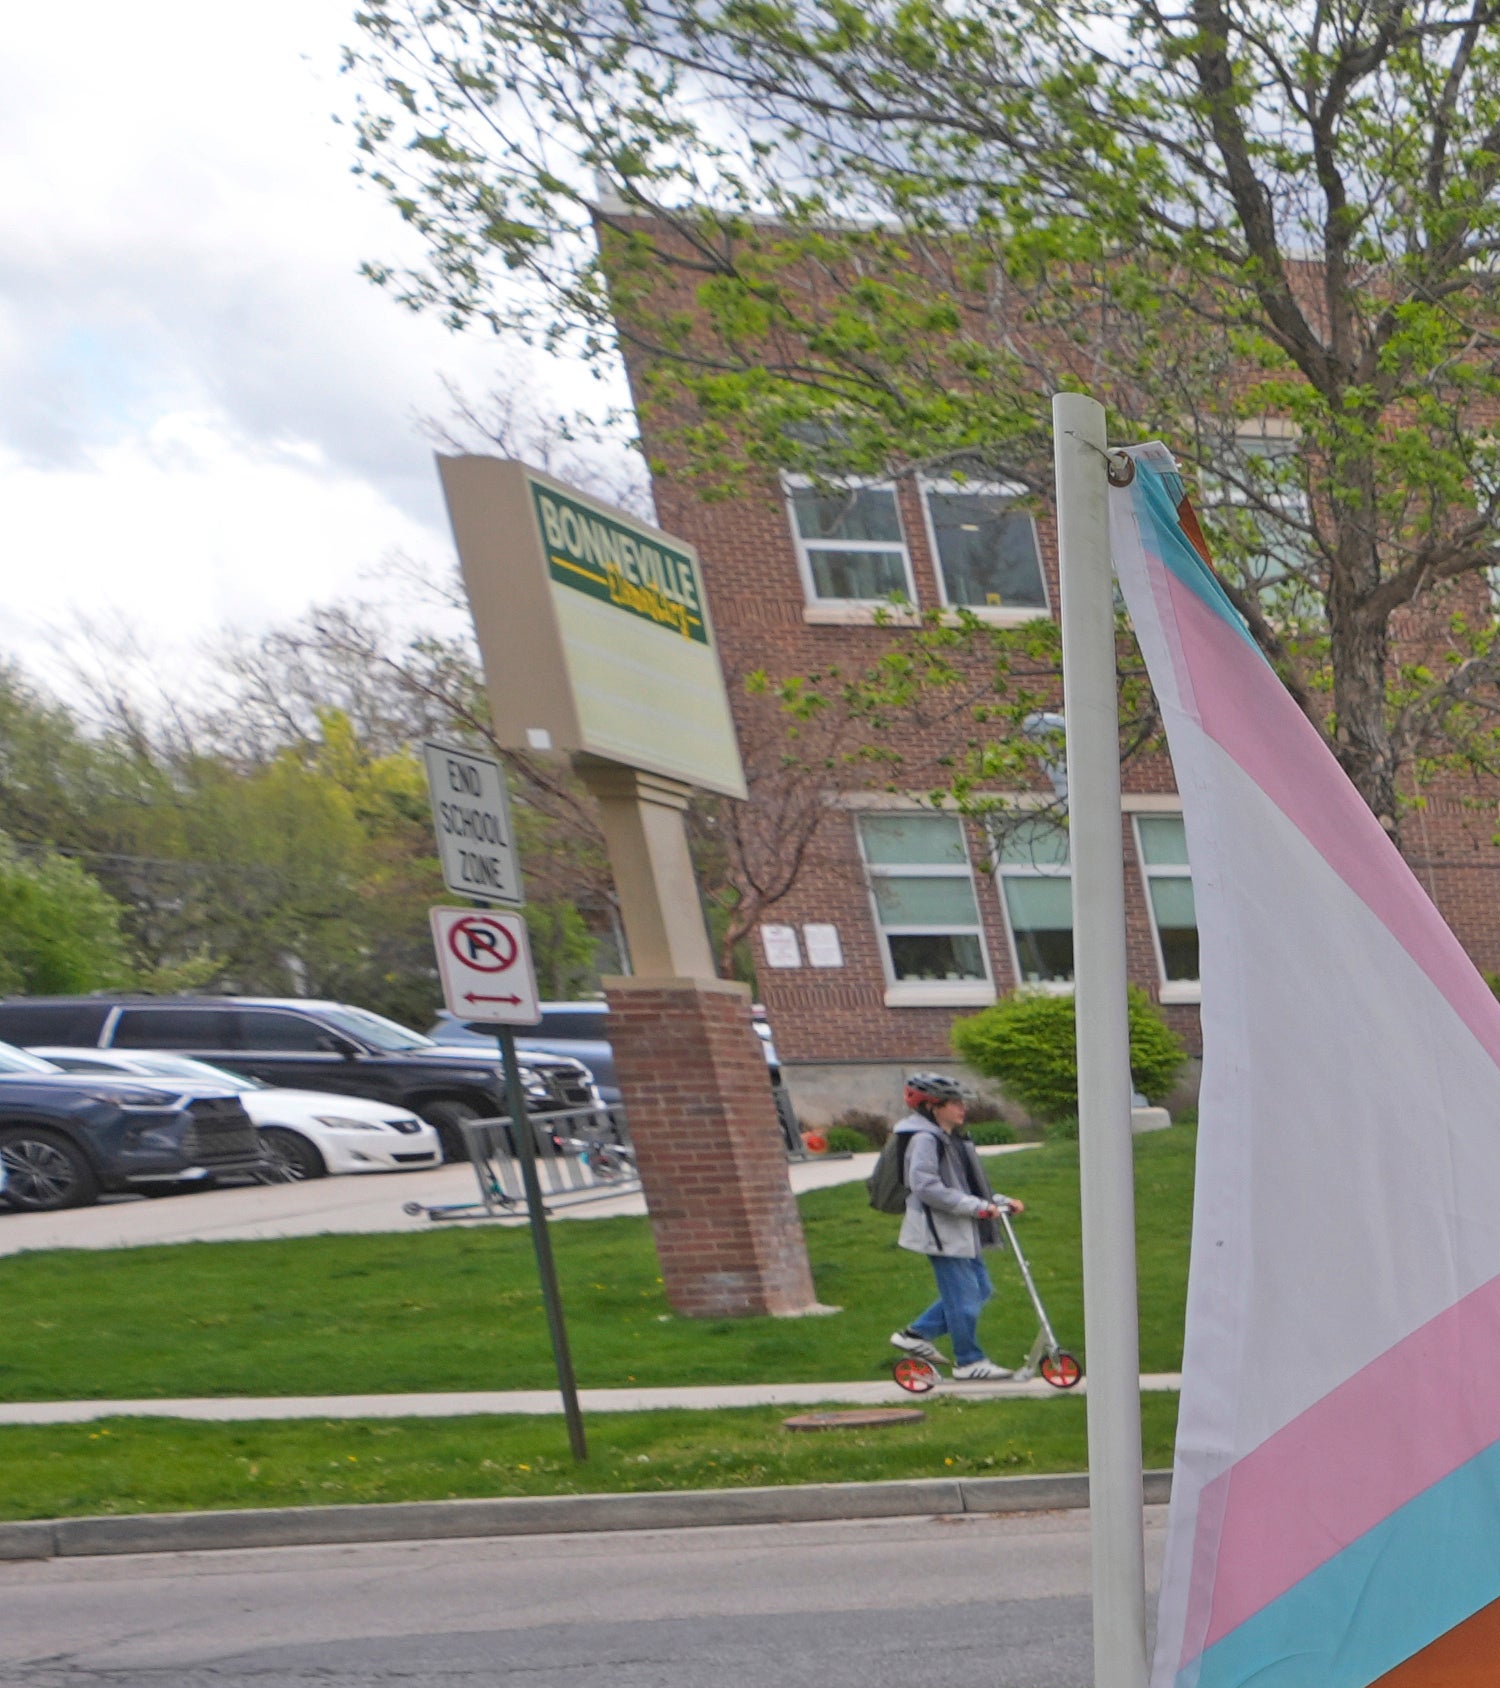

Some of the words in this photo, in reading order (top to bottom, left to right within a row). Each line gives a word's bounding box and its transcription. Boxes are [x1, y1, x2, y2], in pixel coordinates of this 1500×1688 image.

[539, 494, 699, 612] BONNEVILLE
[448, 759, 481, 798] END
[440, 801, 508, 848] SCHOOL
[458, 850, 504, 890] ZONE
